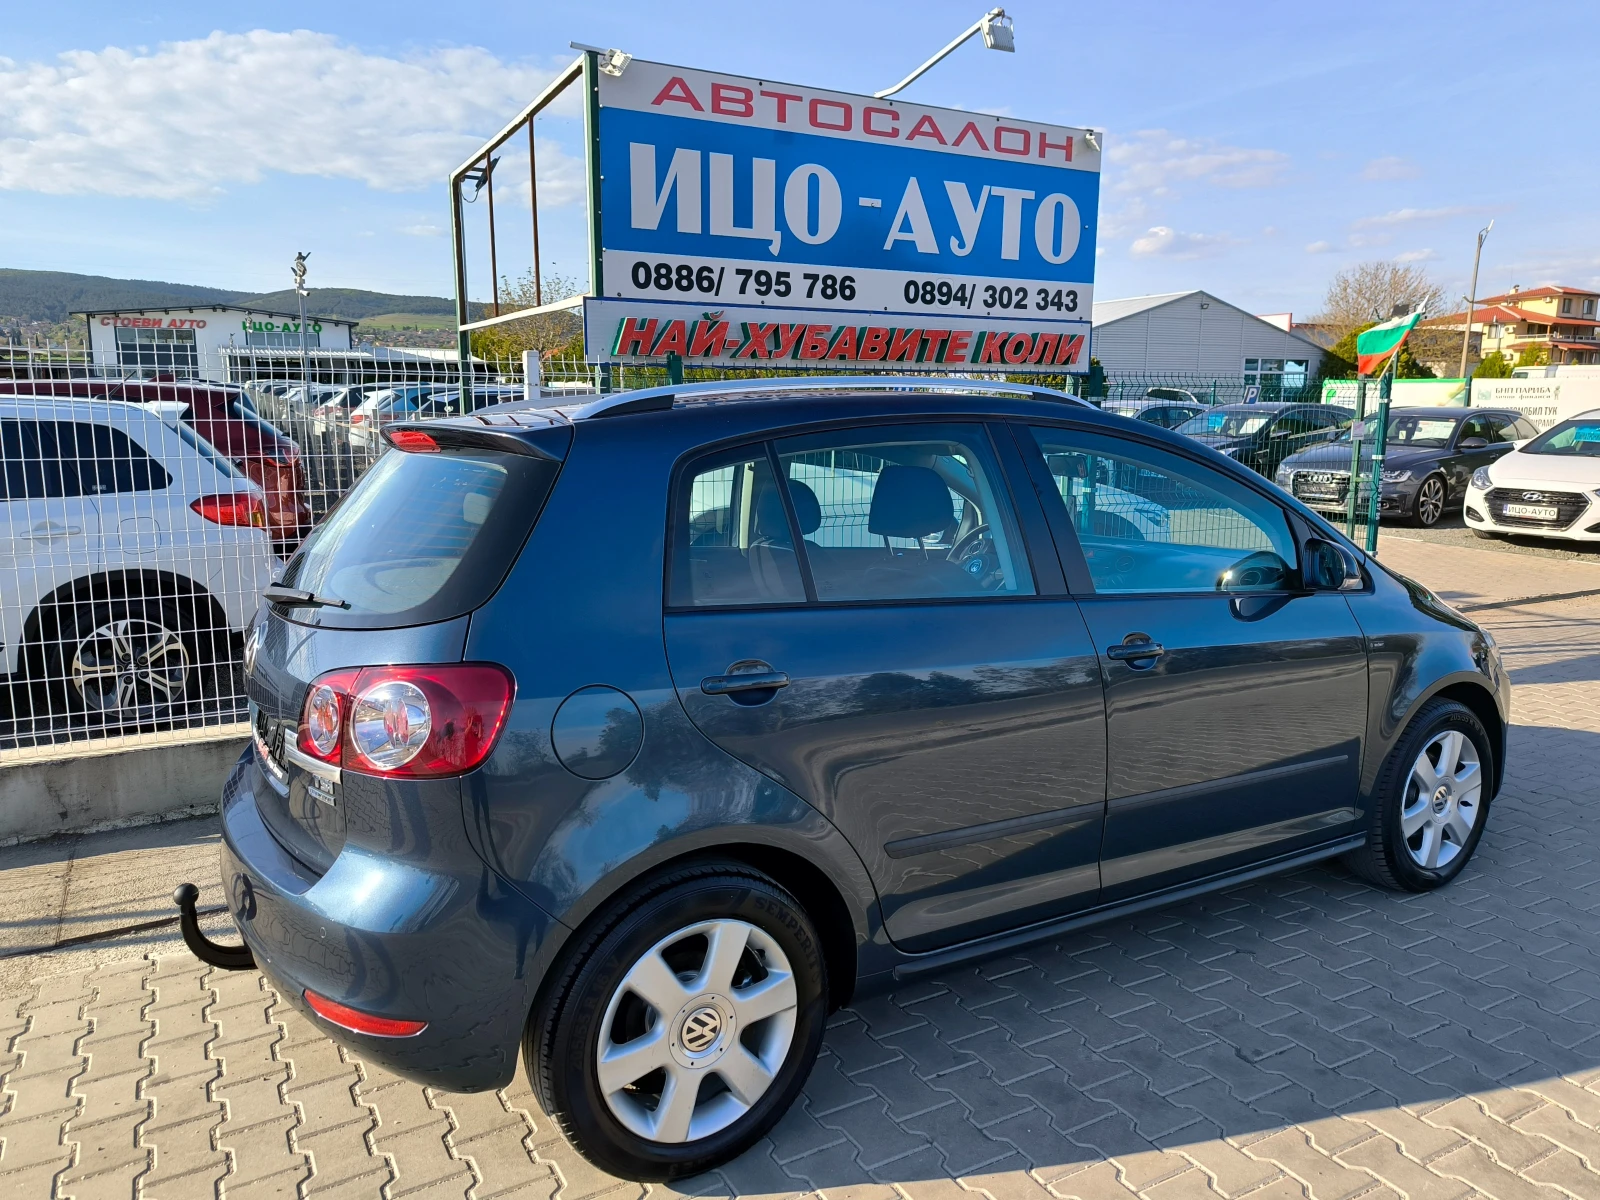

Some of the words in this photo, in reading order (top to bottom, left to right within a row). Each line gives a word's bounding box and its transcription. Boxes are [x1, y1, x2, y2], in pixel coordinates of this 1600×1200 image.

[652, 77, 1072, 161] АВТОСАЛОН
[631, 261, 725, 297] 0886/
[735, 267, 791, 298] 795
[803, 273, 856, 301] 786
[904, 279, 976, 310] 0894/
[983, 284, 1028, 310] 302
[1035, 287, 1078, 312] 343
[101, 316, 162, 328] СТОЕВИ
[167, 319, 207, 329] АУТО
[611, 310, 973, 364] НАЙ-ХУБАВИТЕ
[974, 330, 1085, 365] КОЛИ
[1516, 386, 1551, 394] ПАРИБА
[1544, 407, 1558, 416] ТУК
[1508, 506, 1556, 517] ИЦО-АУТО
